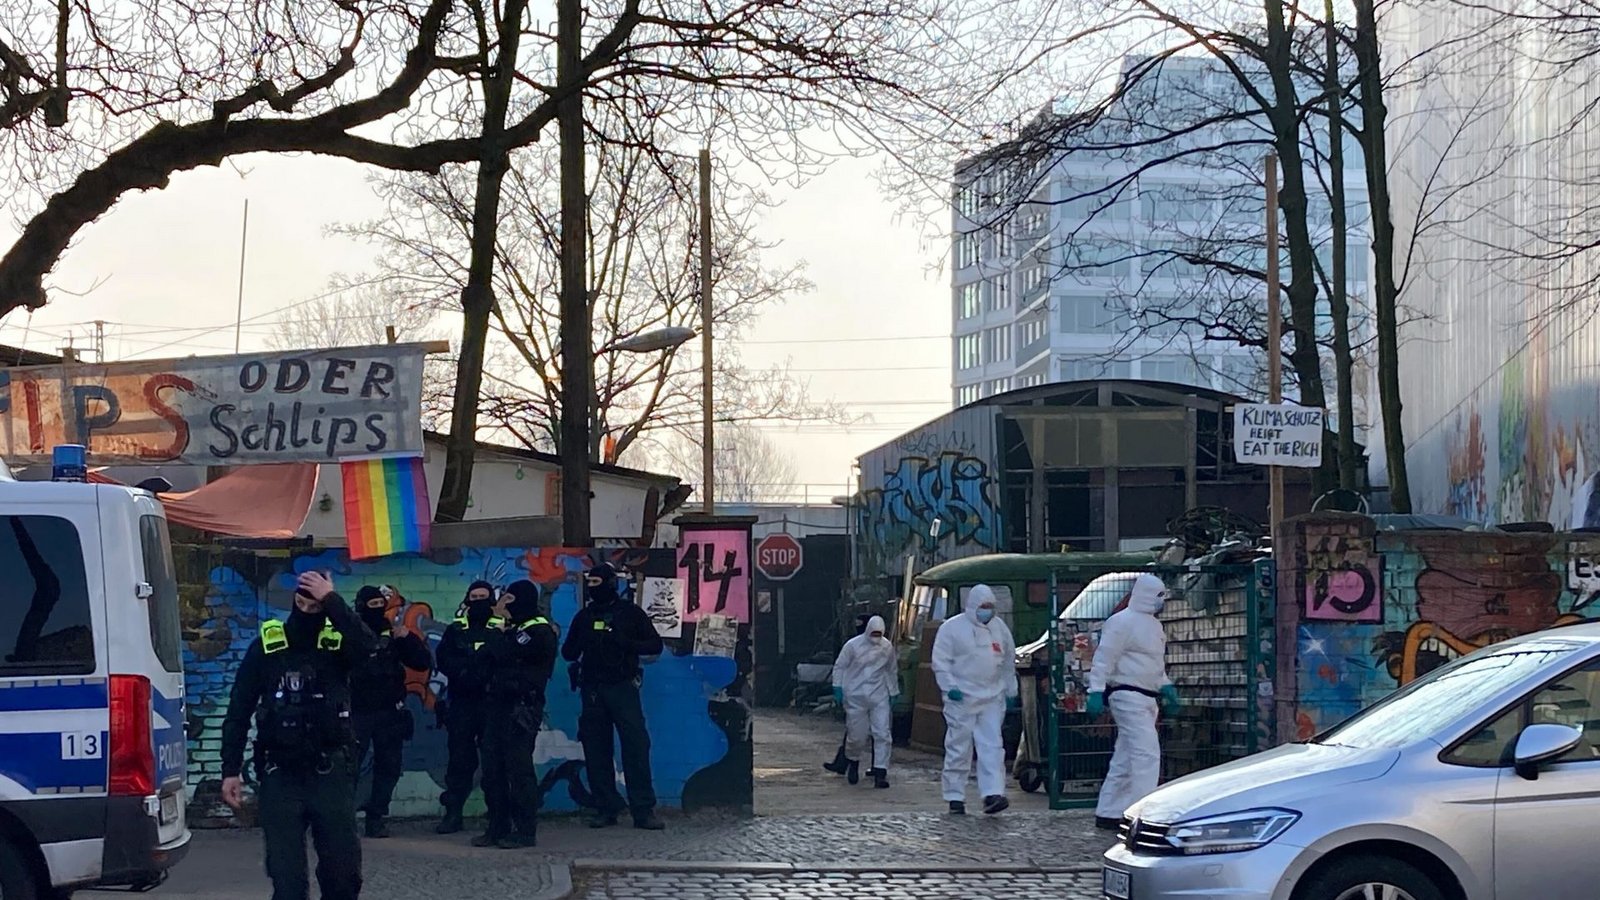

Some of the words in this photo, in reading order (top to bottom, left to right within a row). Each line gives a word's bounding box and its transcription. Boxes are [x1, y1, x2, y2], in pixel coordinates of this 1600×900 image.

[239, 357, 395, 399] ODER
[0, 369, 192, 462] IPS
[209, 401, 387, 458] Schlips
[1242, 407, 1322, 427] KLIMASCHUTZ
[1243, 440, 1270, 457] EAT
[1273, 441, 1291, 456] THE
[1291, 440, 1320, 458] RICH
[762, 548, 797, 565] STOP
[678, 542, 742, 614] 14
[67, 734, 98, 757] 13
